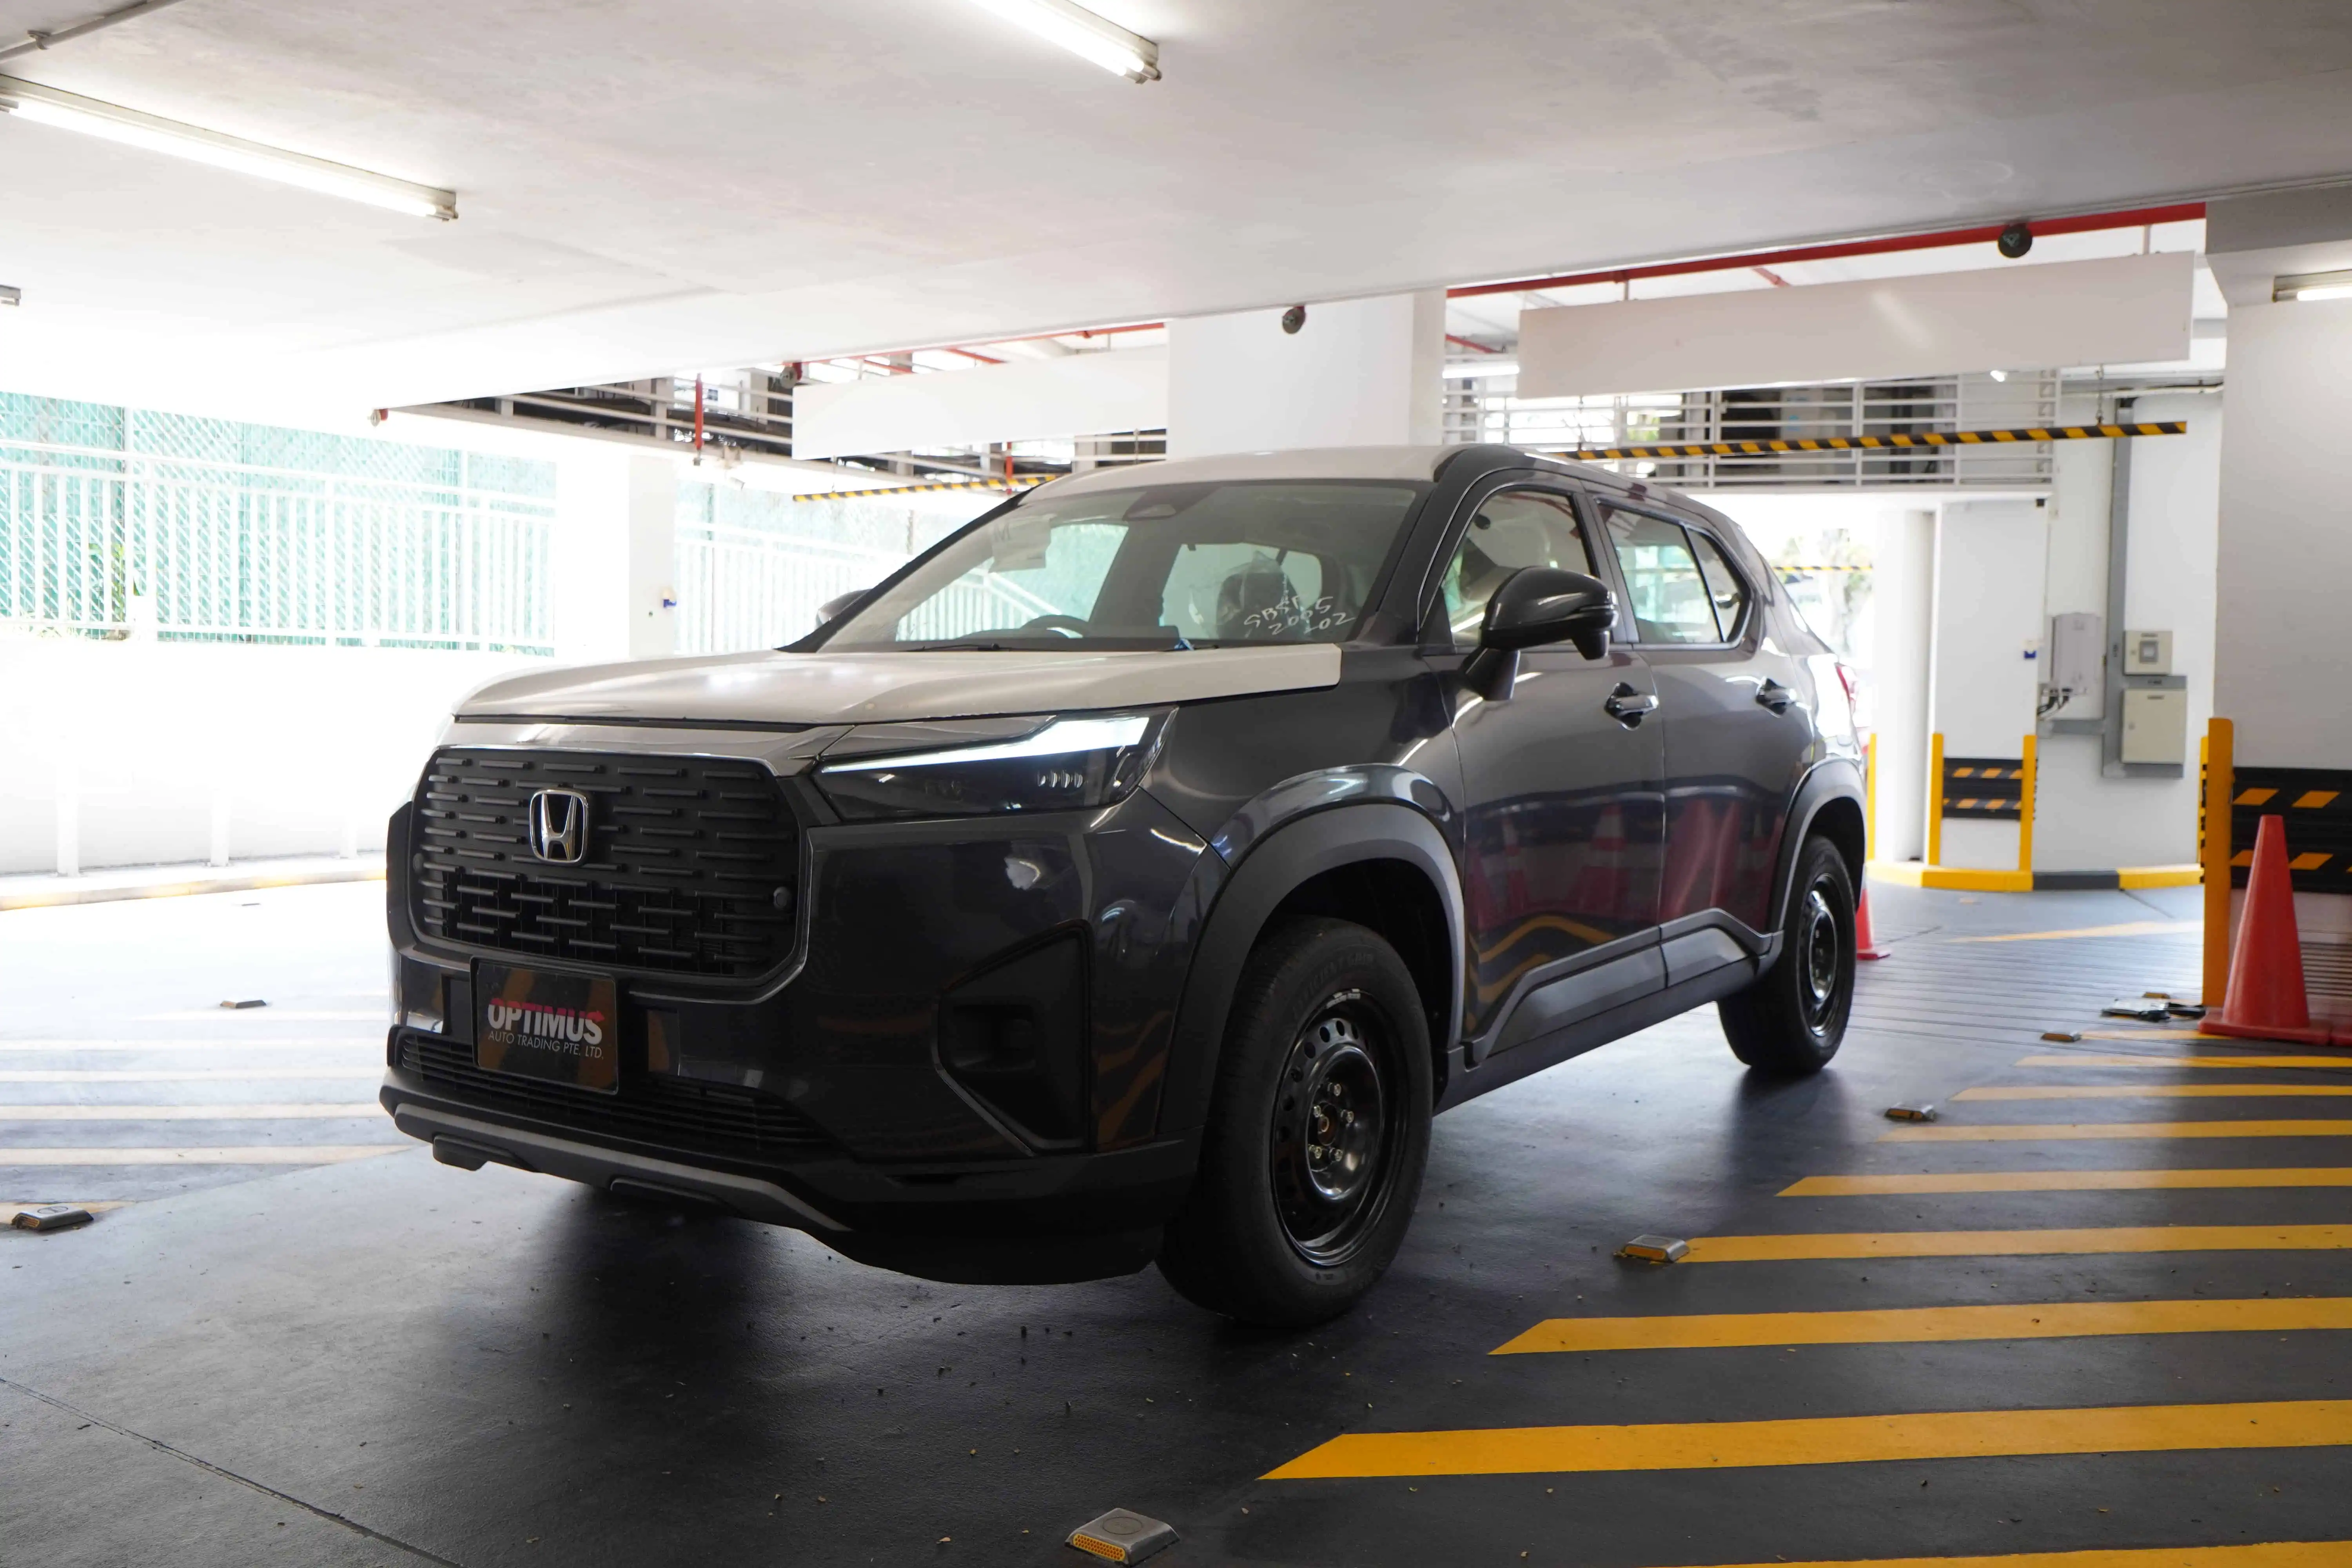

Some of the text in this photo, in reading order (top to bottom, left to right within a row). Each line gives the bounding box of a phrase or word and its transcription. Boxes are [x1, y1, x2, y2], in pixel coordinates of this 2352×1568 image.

[488, 998, 604, 1044] OPTIMUS
[488, 1031, 514, 1044] AUTO
[518, 1035, 560, 1051] TRADING
[563, 1042, 581, 1056] PTE.
